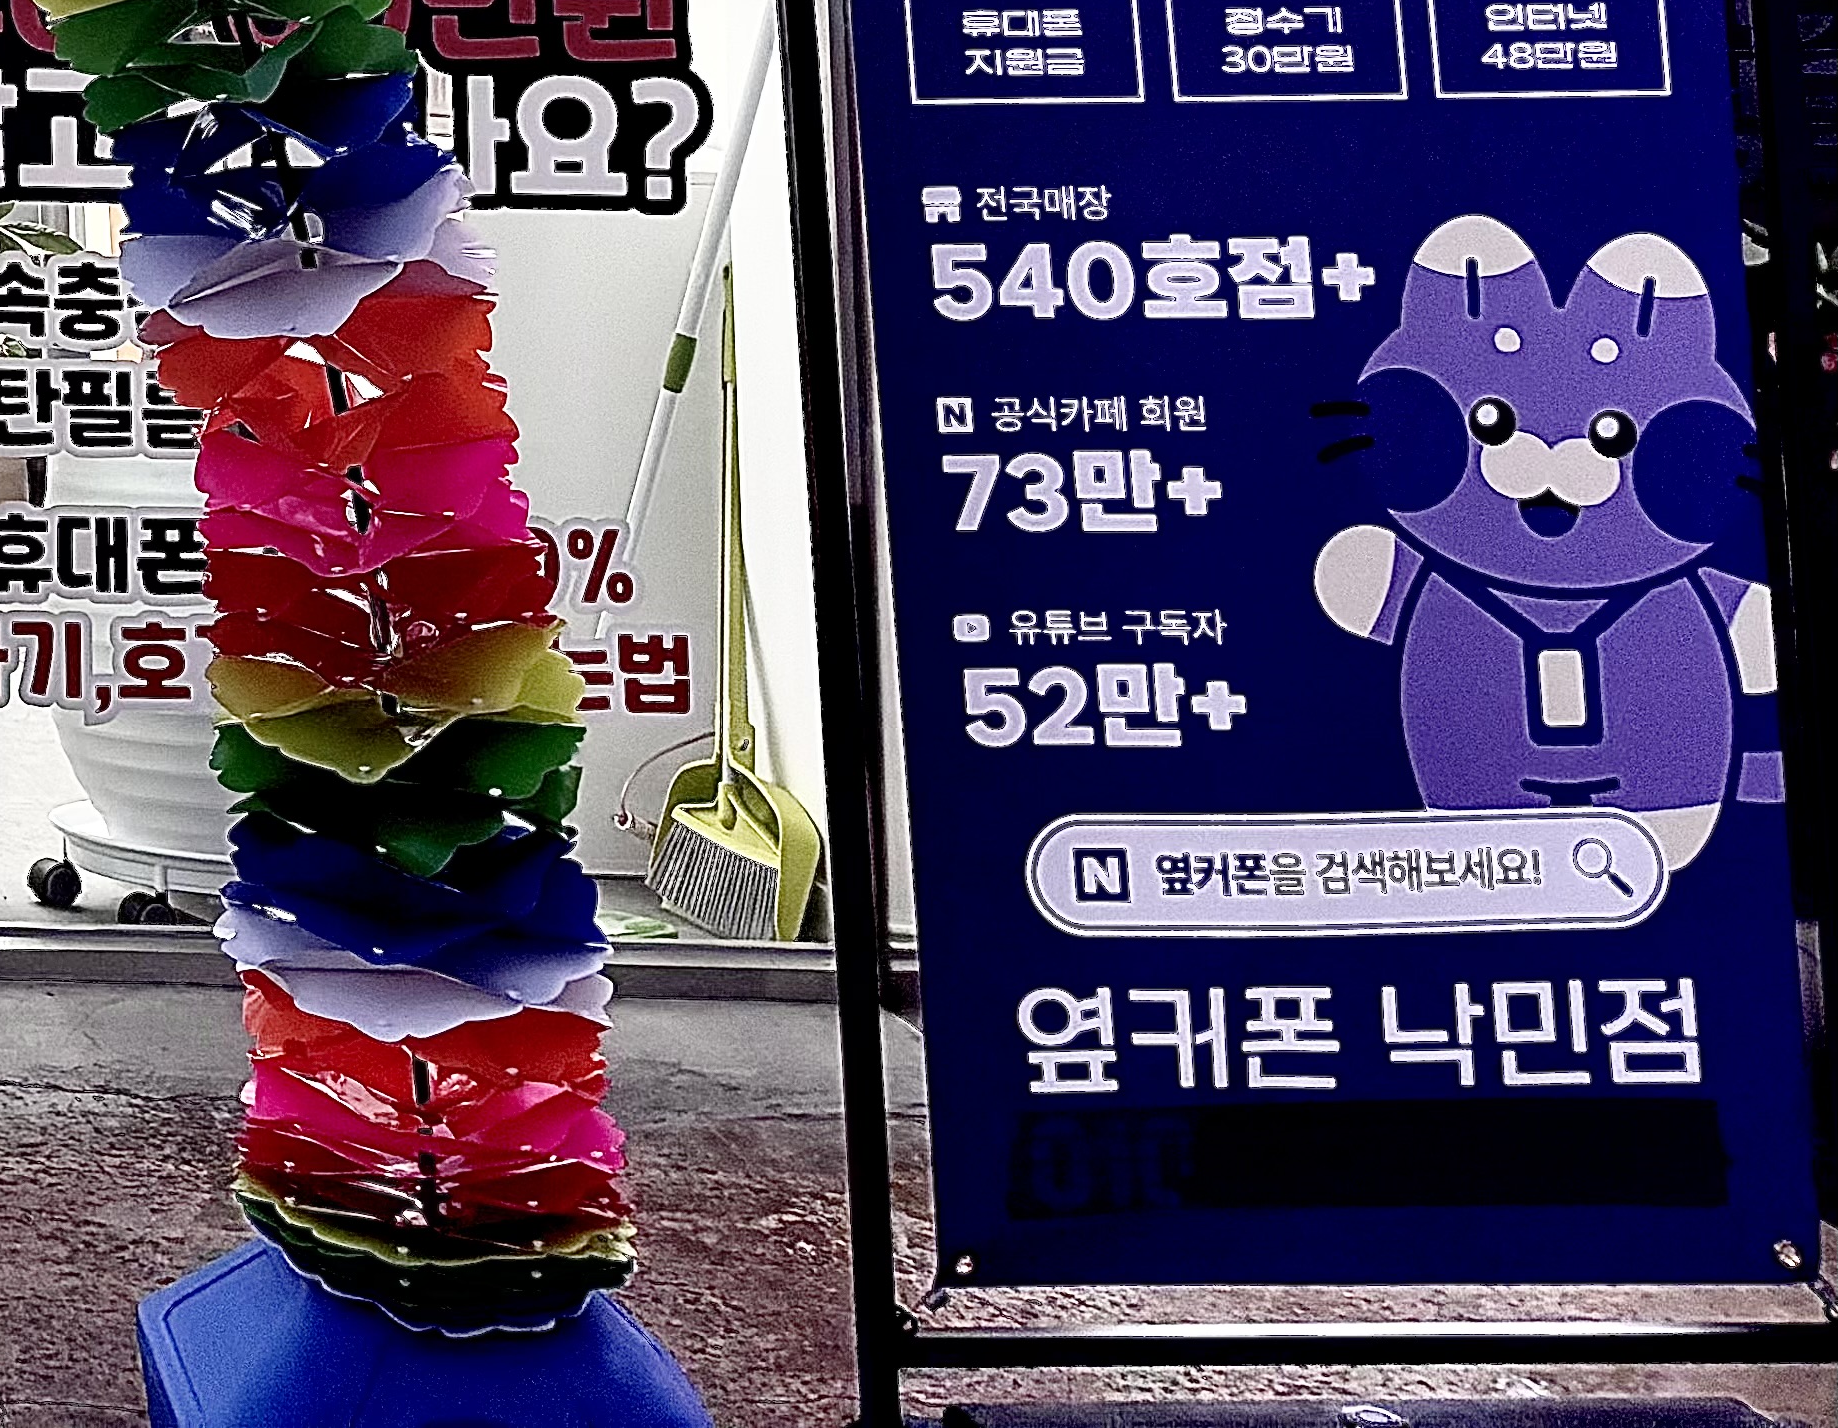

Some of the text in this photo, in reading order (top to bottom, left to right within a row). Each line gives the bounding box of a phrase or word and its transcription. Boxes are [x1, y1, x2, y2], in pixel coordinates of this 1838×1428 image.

[1223, 5, 1344, 36] 정수기
[1483, 1, 1610, 33] 인터넷
[964, 47, 1086, 77] 지원금
[1220, 43, 1355, 75] 30만원
[1480, 39, 1619, 70] 48만원
[974, 184, 1112, 222] 전국매장
[930, 233, 1376, 321] 540호점+
[991, 396, 1129, 432] 공식카페
[1138, 394, 1208, 432] 회원
[940, 447, 1223, 533] 73만+
[1008, 609, 1228, 646] 유튜브 구독자
[962, 661, 1248, 748] 52만+
[1154, 850, 1305, 897] 옆커폰을
[1314, 846, 1543, 896] 검색해보세요!
[1016, 976, 1703, 1095] 옆커폰 낙민점
